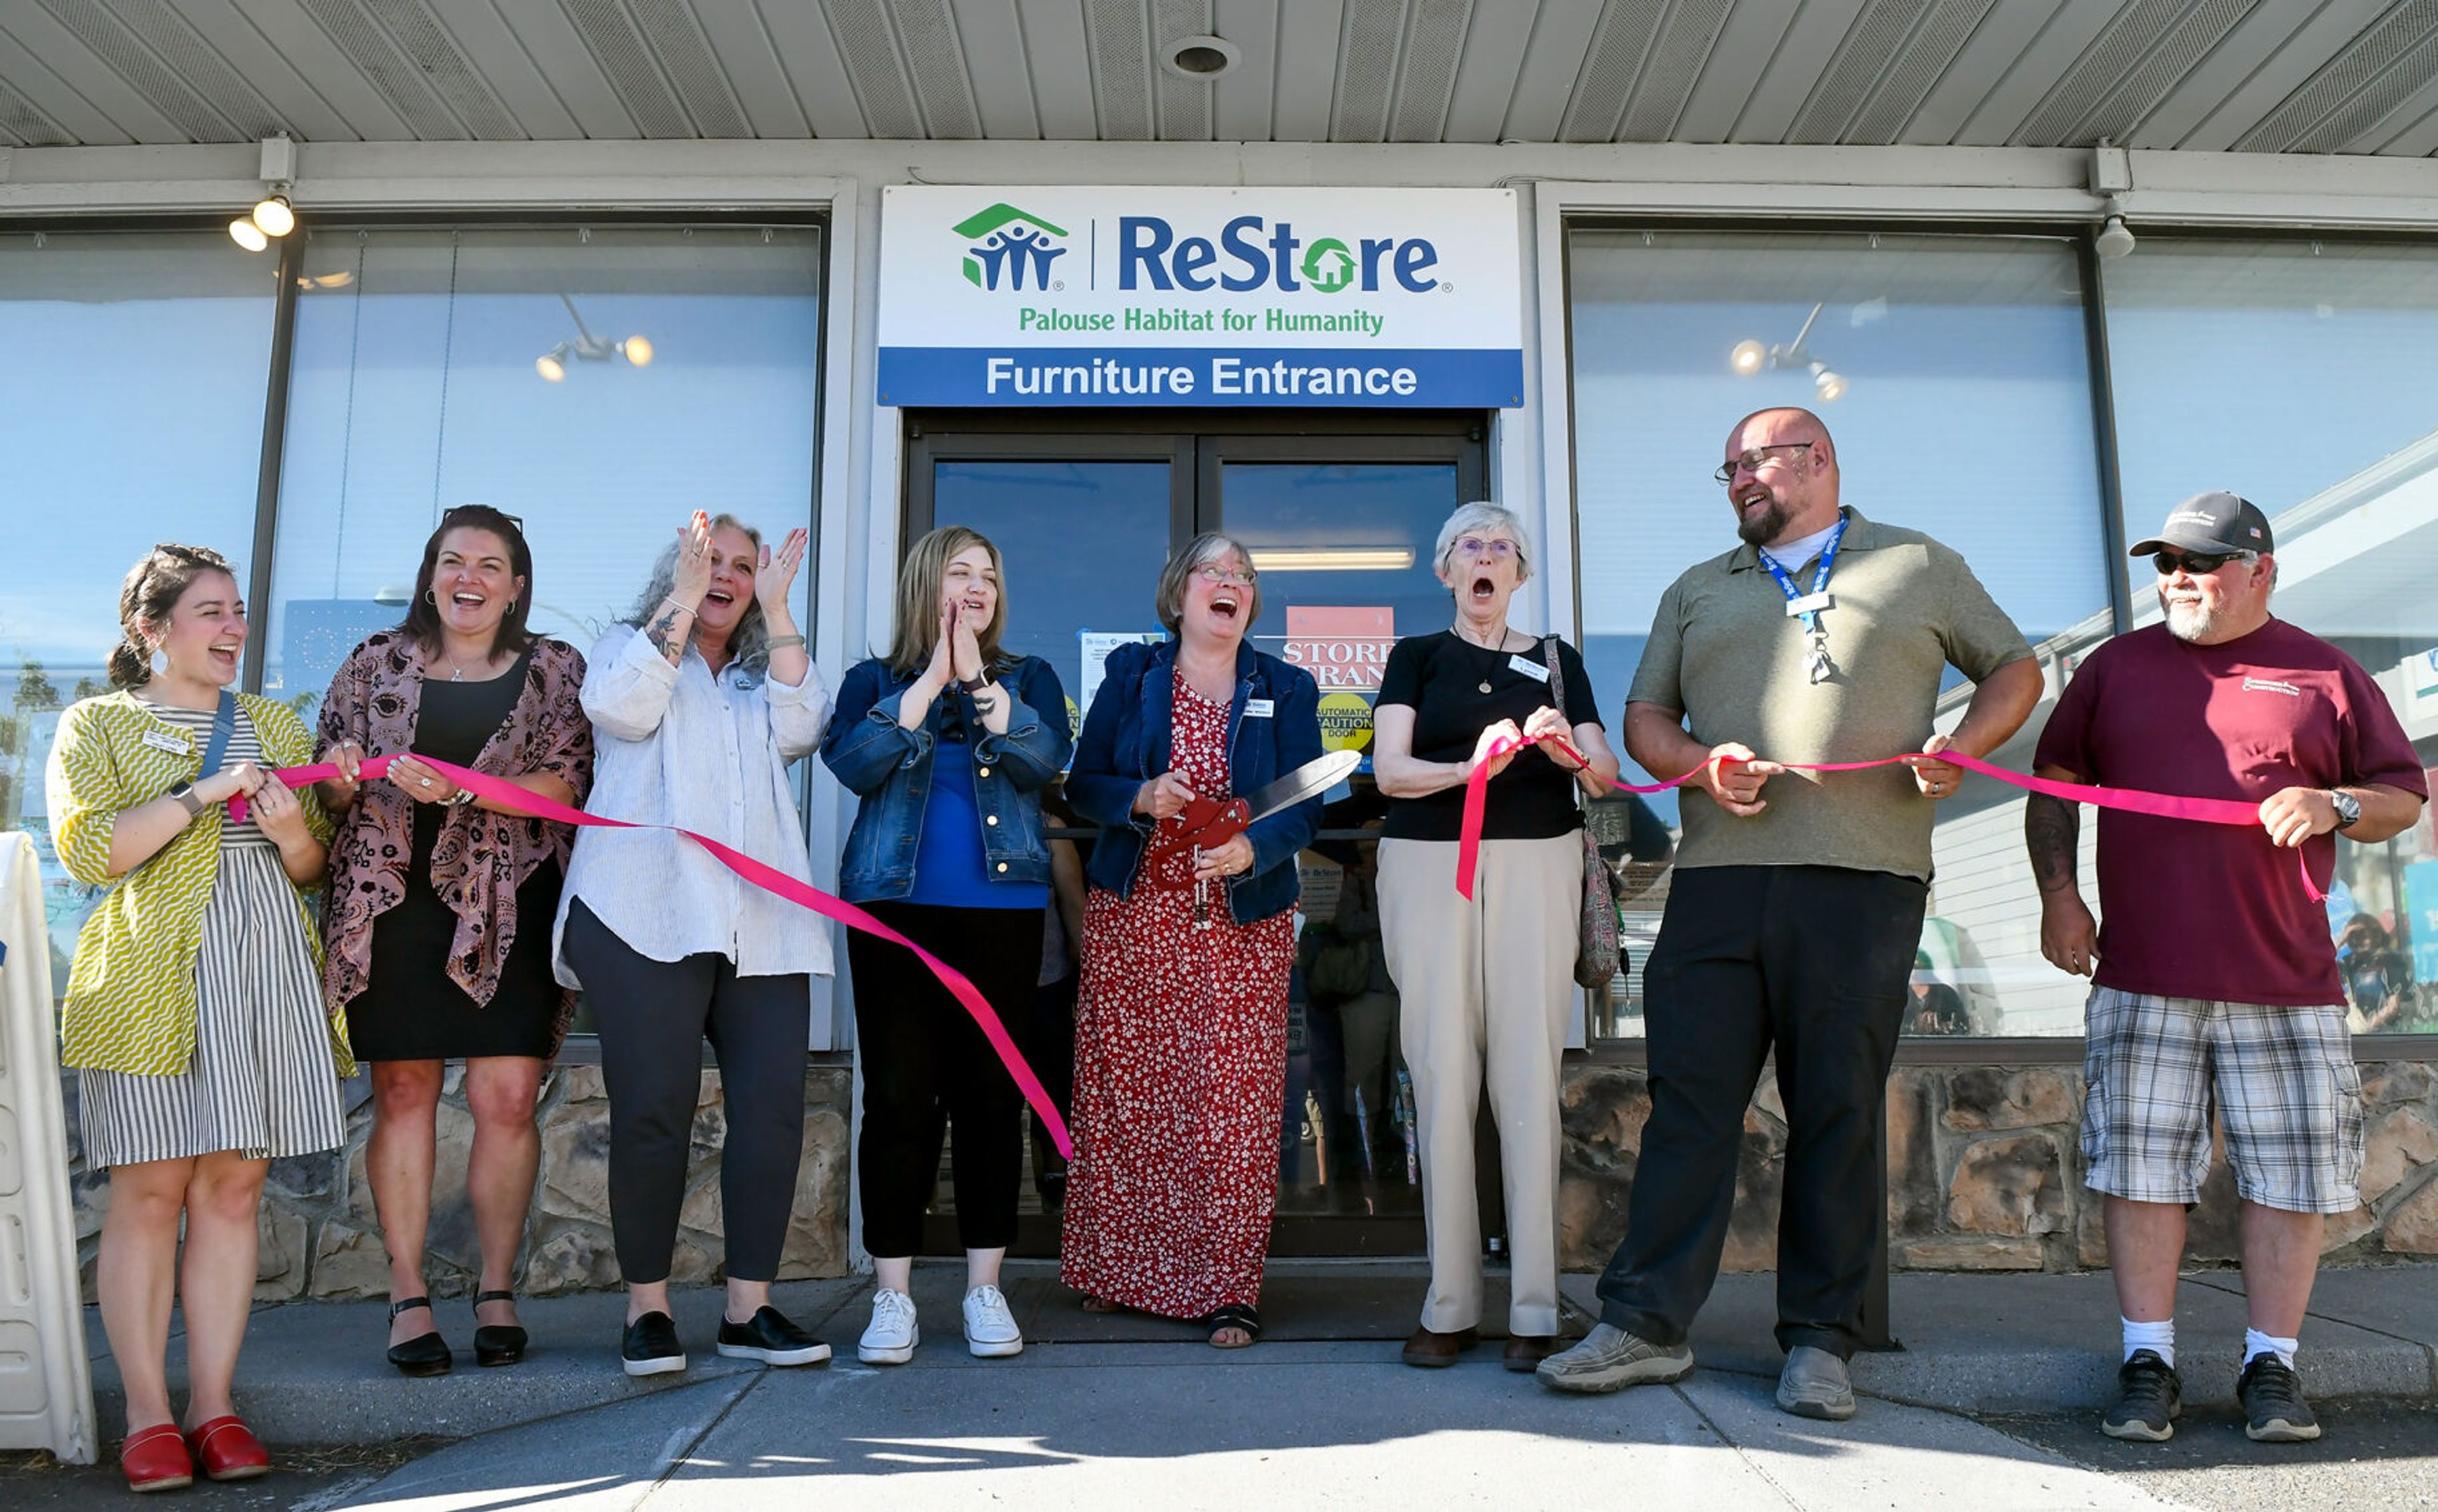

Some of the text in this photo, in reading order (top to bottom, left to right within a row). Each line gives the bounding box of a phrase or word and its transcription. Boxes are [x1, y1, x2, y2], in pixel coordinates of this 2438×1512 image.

[1119, 216, 1438, 293] ReStore
[1019, 307, 1384, 338] Palouse Habitat for Humanity
[987, 357, 1417, 395] Furniture Entrance
[1317, 718, 1373, 728] AUTION
[1328, 729, 1357, 738] DOOR
